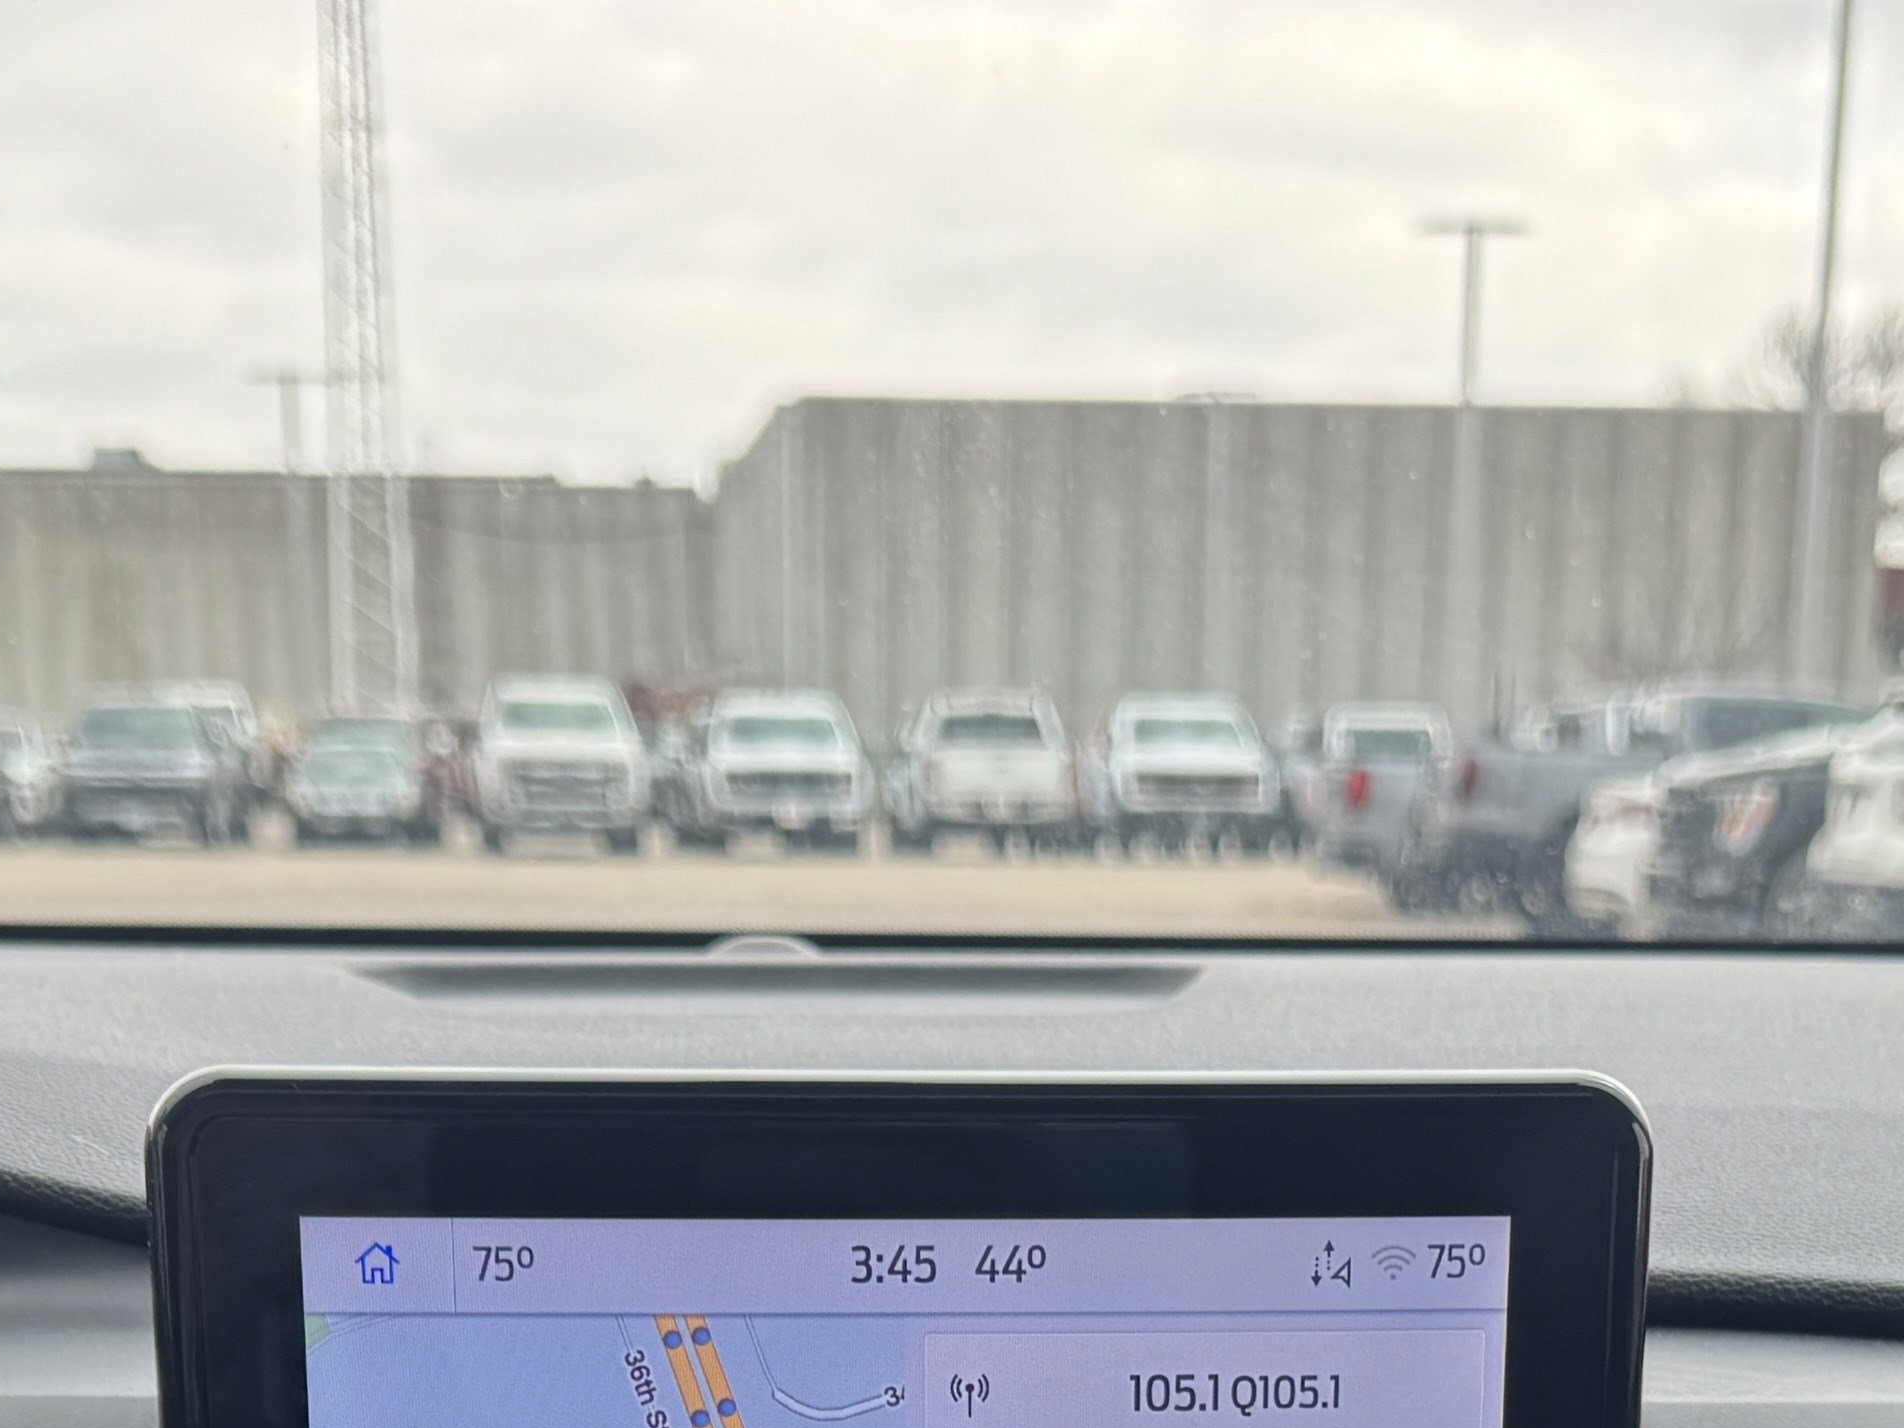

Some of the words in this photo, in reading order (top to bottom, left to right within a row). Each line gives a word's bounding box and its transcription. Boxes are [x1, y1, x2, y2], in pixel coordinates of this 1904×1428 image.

[850, 1244, 937, 1284] 3:45
[624, 1349, 655, 1406] 36th
[1129, 1373, 1219, 1412] 105.1
[1231, 1374, 1340, 1417] Q105.1
